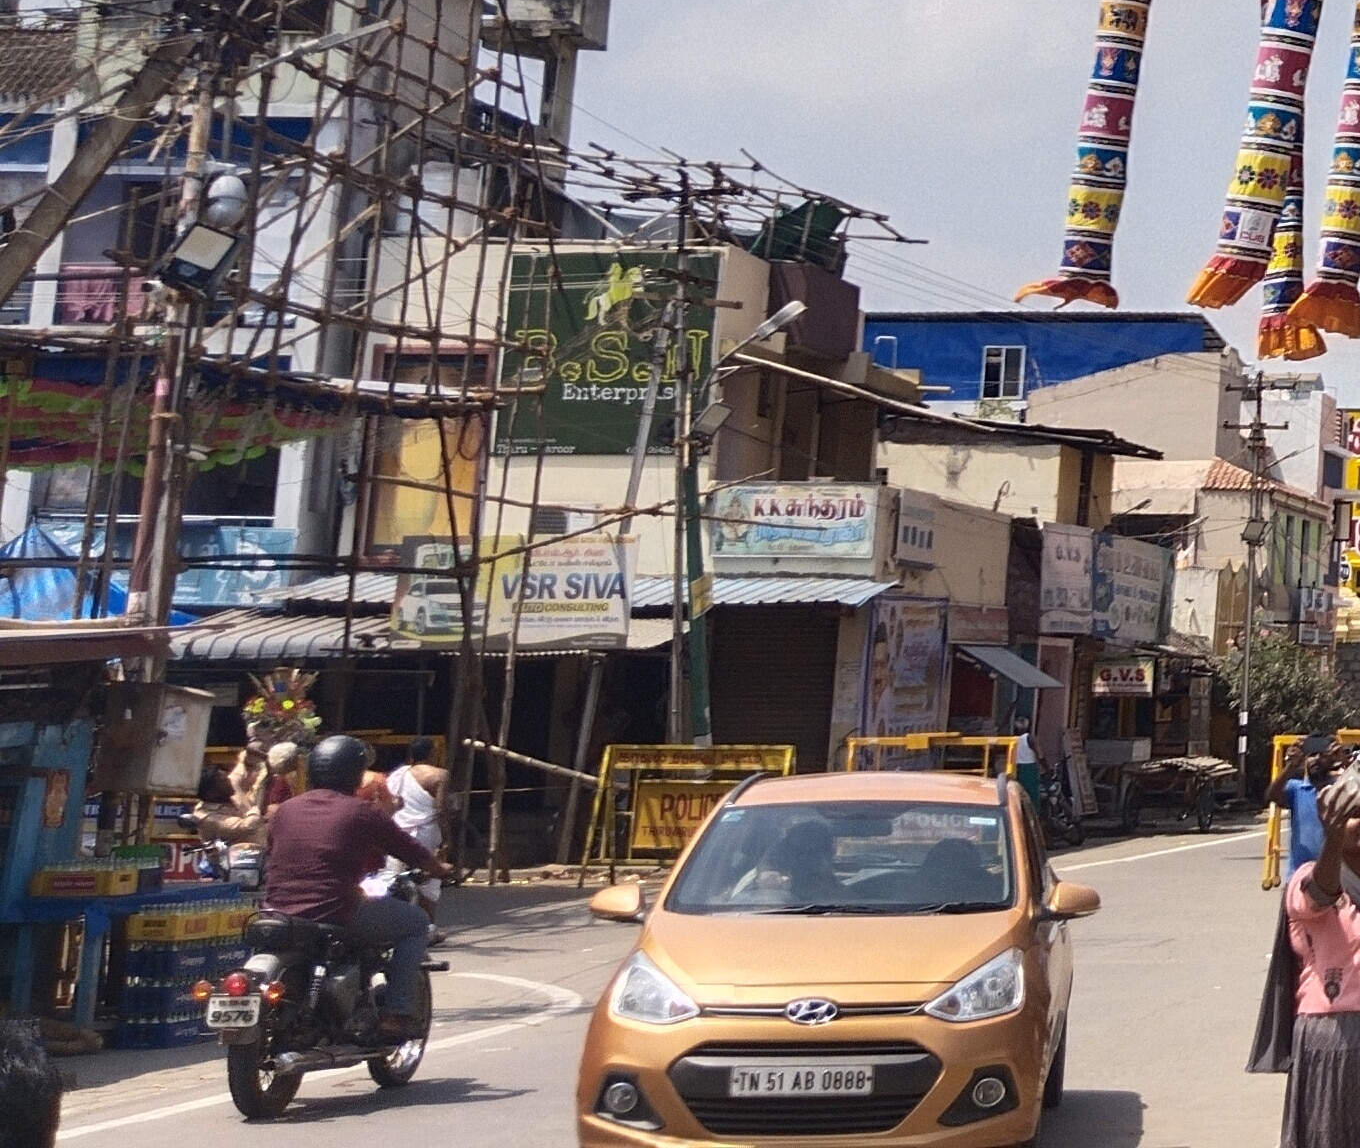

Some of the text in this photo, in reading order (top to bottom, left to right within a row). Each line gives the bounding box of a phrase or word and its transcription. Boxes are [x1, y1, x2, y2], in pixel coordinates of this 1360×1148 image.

[502, 572, 628, 600] VSR SIVA
[545, 602, 609, 612] CONSULTING
[1099, 667, 1146, 683] G.V.S
[211, 1010, 255, 1023] 9576
[739, 1069, 866, 1091] TN 51 AB 0888
